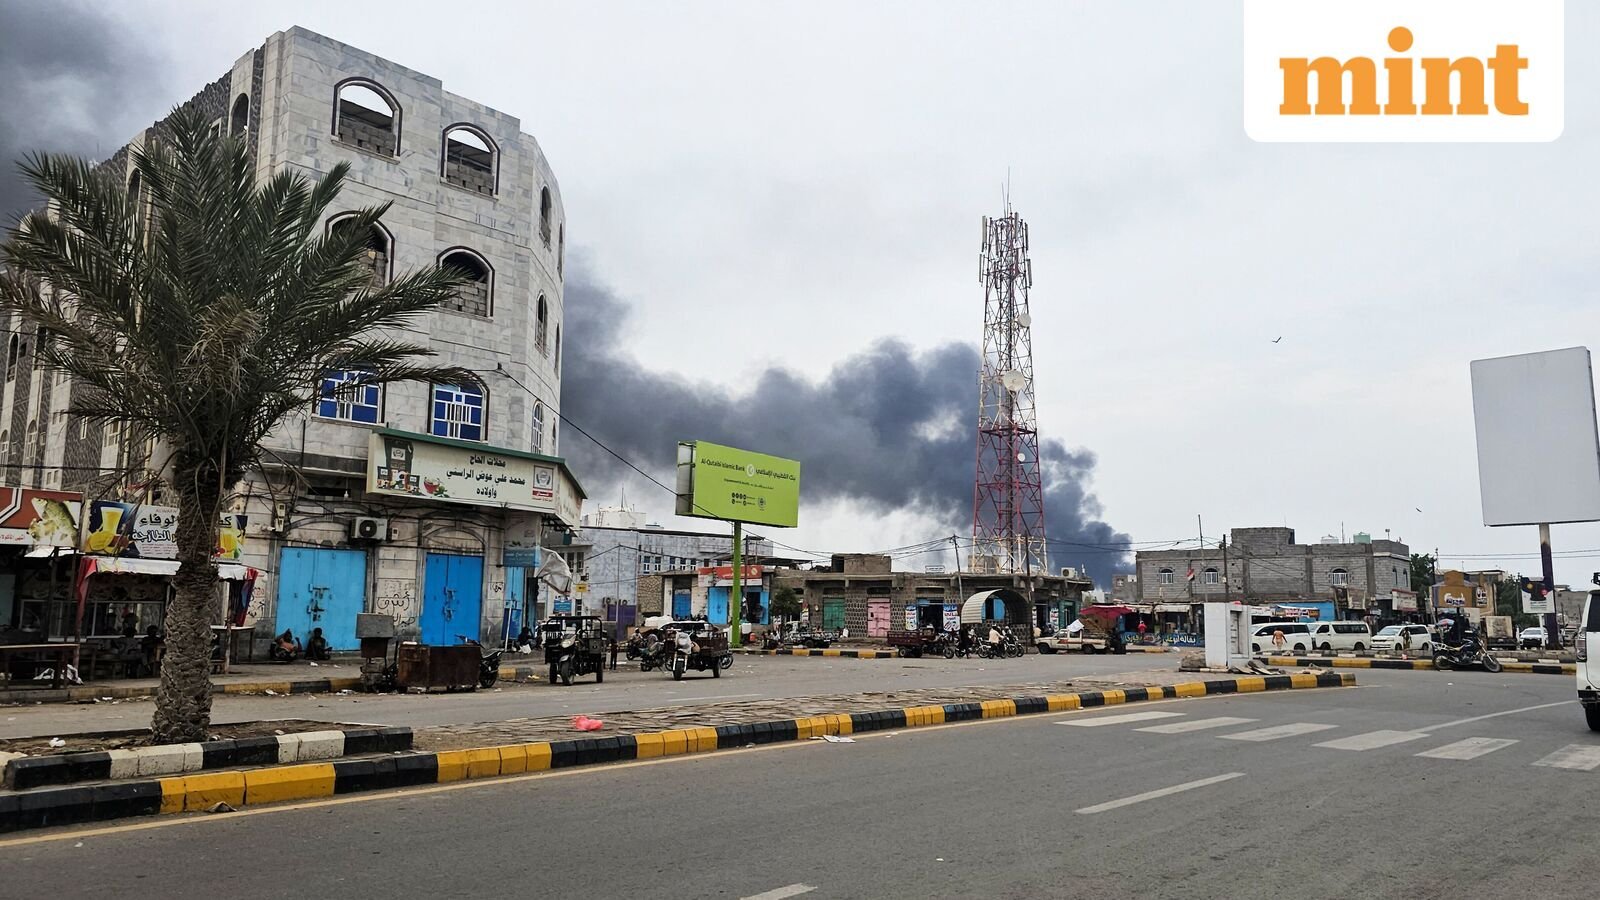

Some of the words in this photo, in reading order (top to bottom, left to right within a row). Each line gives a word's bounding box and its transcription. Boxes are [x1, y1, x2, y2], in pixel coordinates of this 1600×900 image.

[469, 453, 486, 465] الحاج
[486, 456, 506, 468] محلات
[735, 464, 745, 472] Bank
[475, 470, 493, 482] عوض
[494, 474, 507, 486] علي
[509, 477, 526, 485] محمد
[132, 529, 171, 543] الطازجة
